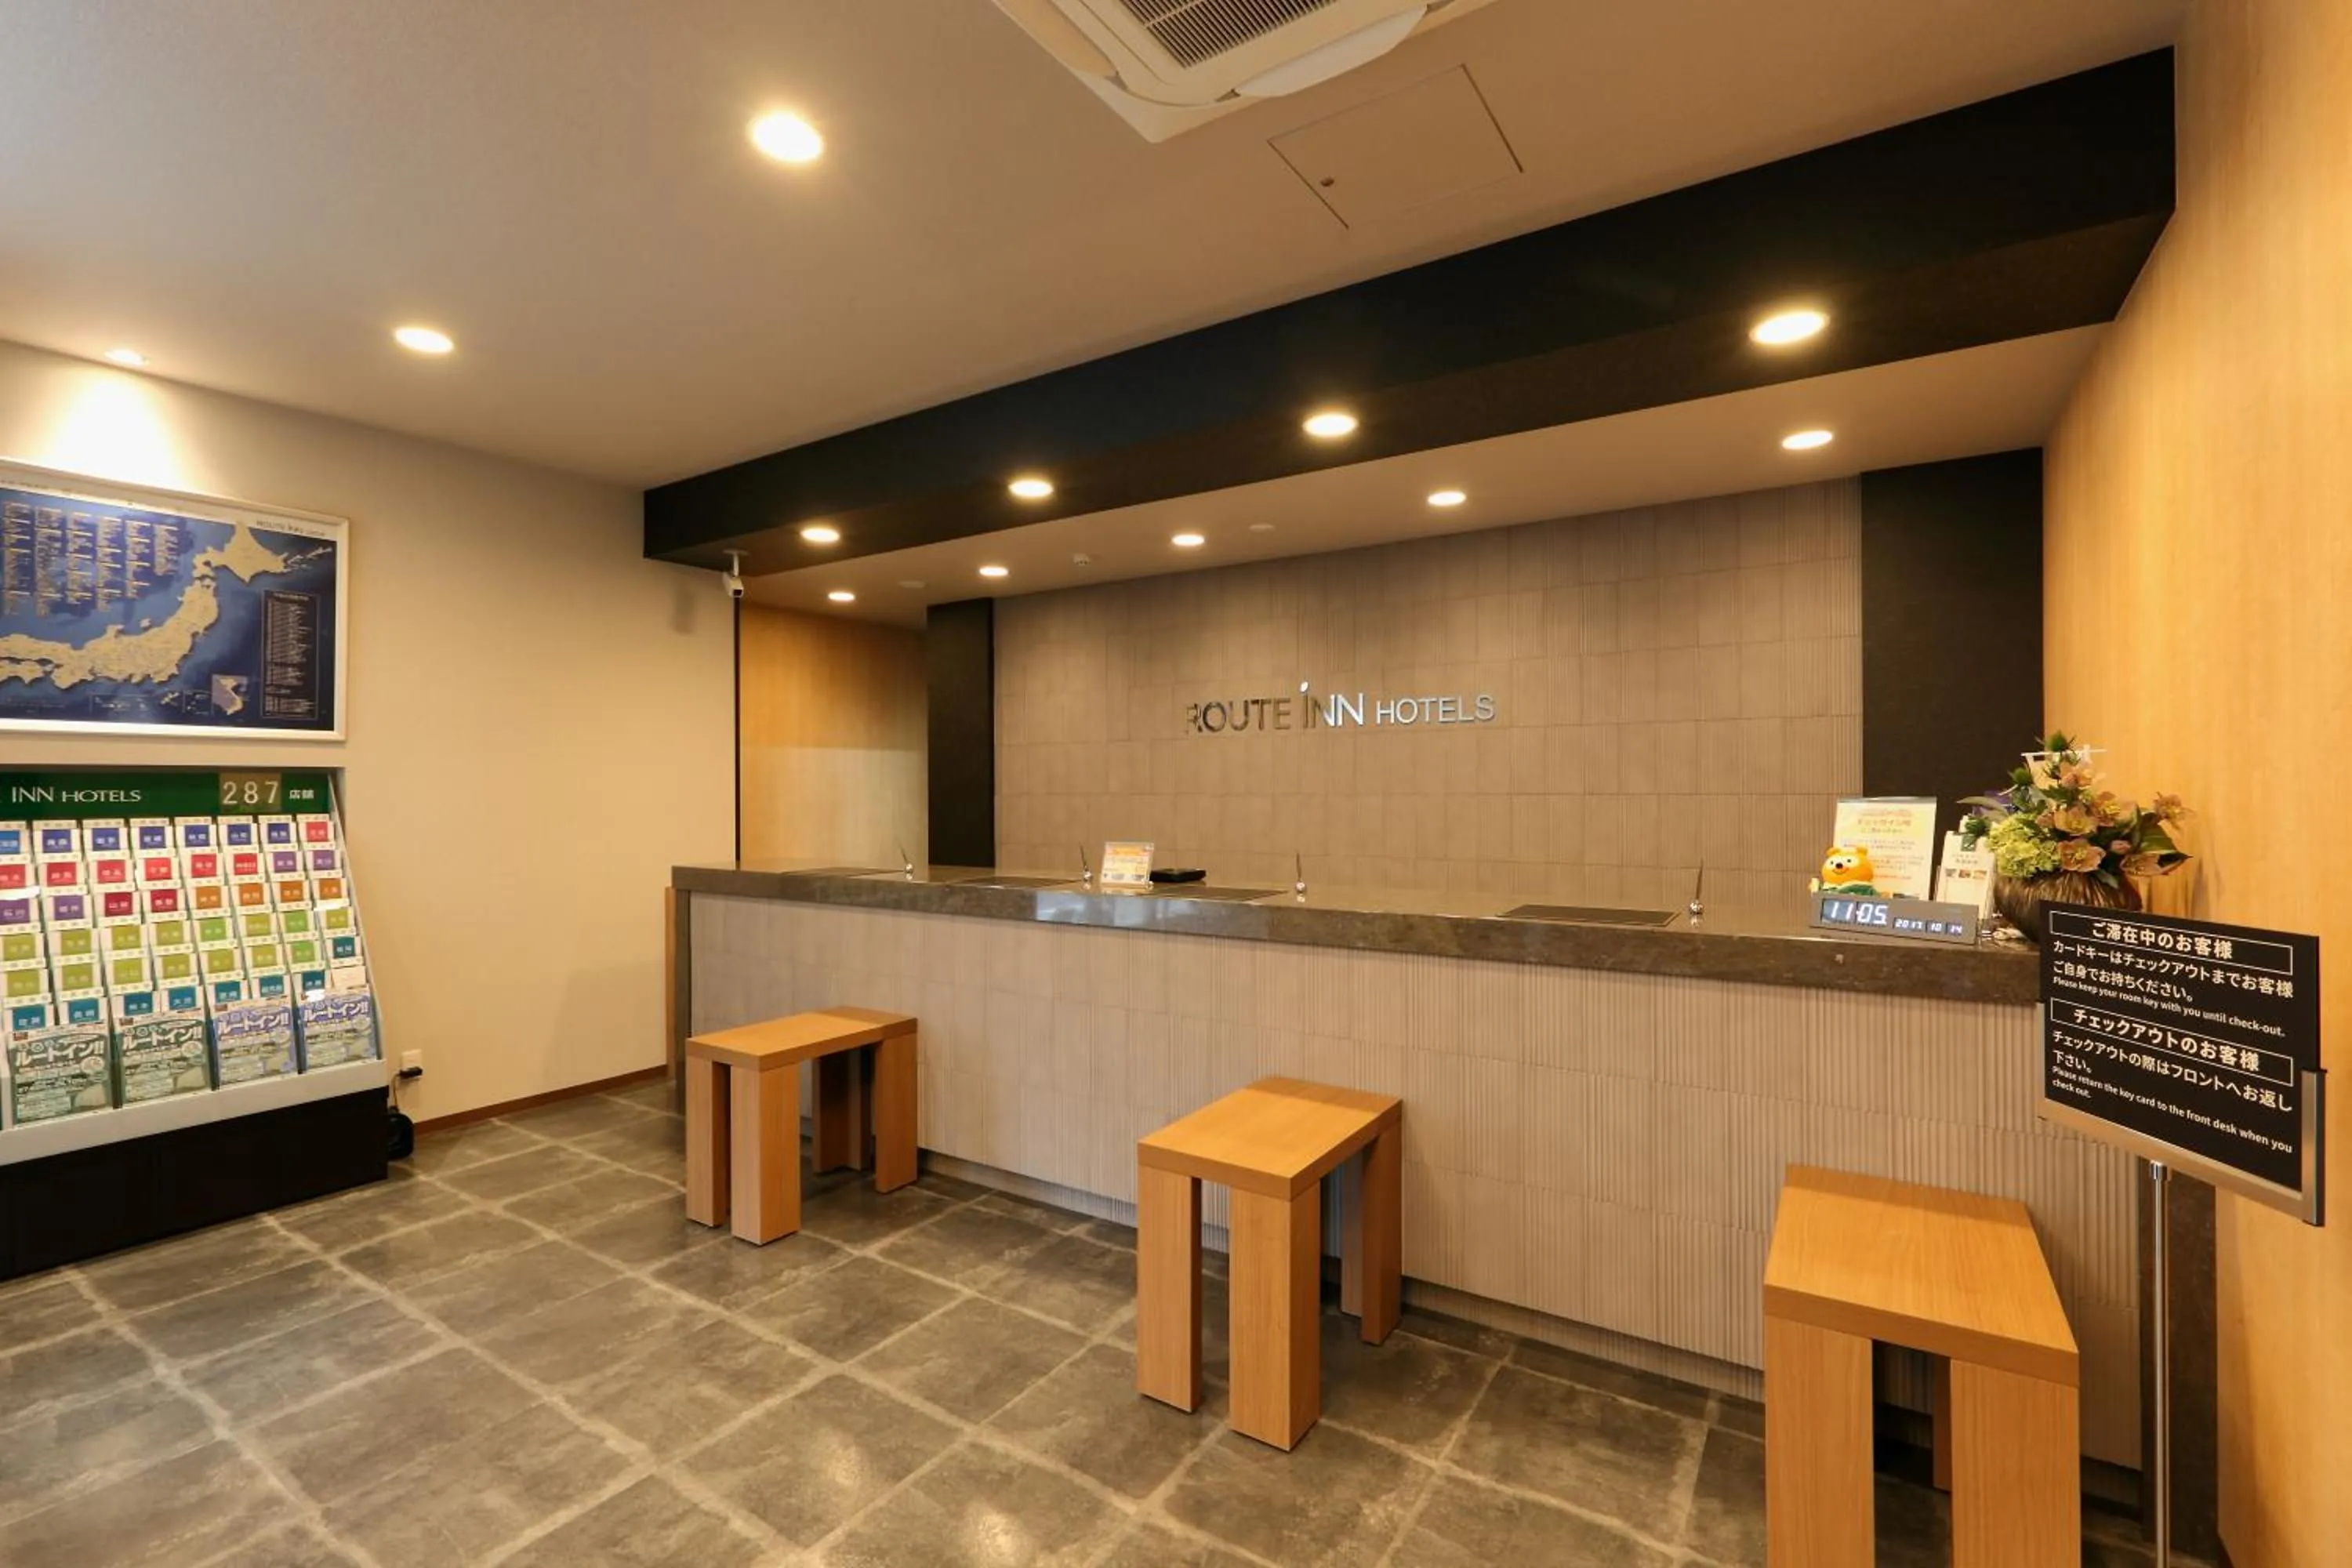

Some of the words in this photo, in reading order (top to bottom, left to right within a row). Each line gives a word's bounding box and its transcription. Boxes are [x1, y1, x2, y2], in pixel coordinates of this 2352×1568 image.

[1185, 697, 1291, 735] ROUTE
[1376, 694, 1494, 725] HOTELS
[12, 786, 54, 803] INN
[62, 789, 142, 802] HOTELS
[2092, 922, 2233, 960] ご滞在中のお客様
[2053, 941, 2293, 998] カードキーはチェックアウトまでお客様
[2053, 960, 2193, 1002] ご自身でお持ちください。
[2053, 976, 2078, 989] Please
[2078, 982, 2098, 994] keep
[2099, 988, 2118, 997] your
[2119, 993, 2142, 1003] room
[2143, 996, 2159, 1009] key
[2160, 1001, 2181, 1013] with
[2183, 1007, 2201, 1017] you
[2203, 1011, 2227, 1023] until
[2229, 1016, 2285, 1037] check-out.
[2053, 1050, 2092, 1073] 下さい。
[2074, 1009, 2259, 1072] チェックアウトのお客様
[2052, 1079, 2074, 1092] check
[2053, 1030, 2292, 1111] チェックアウトの際はフロントへお返し
[2052, 1065, 2077, 1081] Please
[2078, 1075, 2103, 1089] return
[2104, 1083, 2118, 1095] the
[2119, 1087, 2135, 1101] key
[2136, 1094, 2155, 1107] card
[2158, 1101, 2168, 1111] to
[2169, 1105, 2185, 1117] the
[2187, 1109, 2211, 1127] front
[2213, 1120, 2237, 1135] desk
[2239, 1128, 2269, 1145] when
[2271, 1139, 2292, 1153] you
